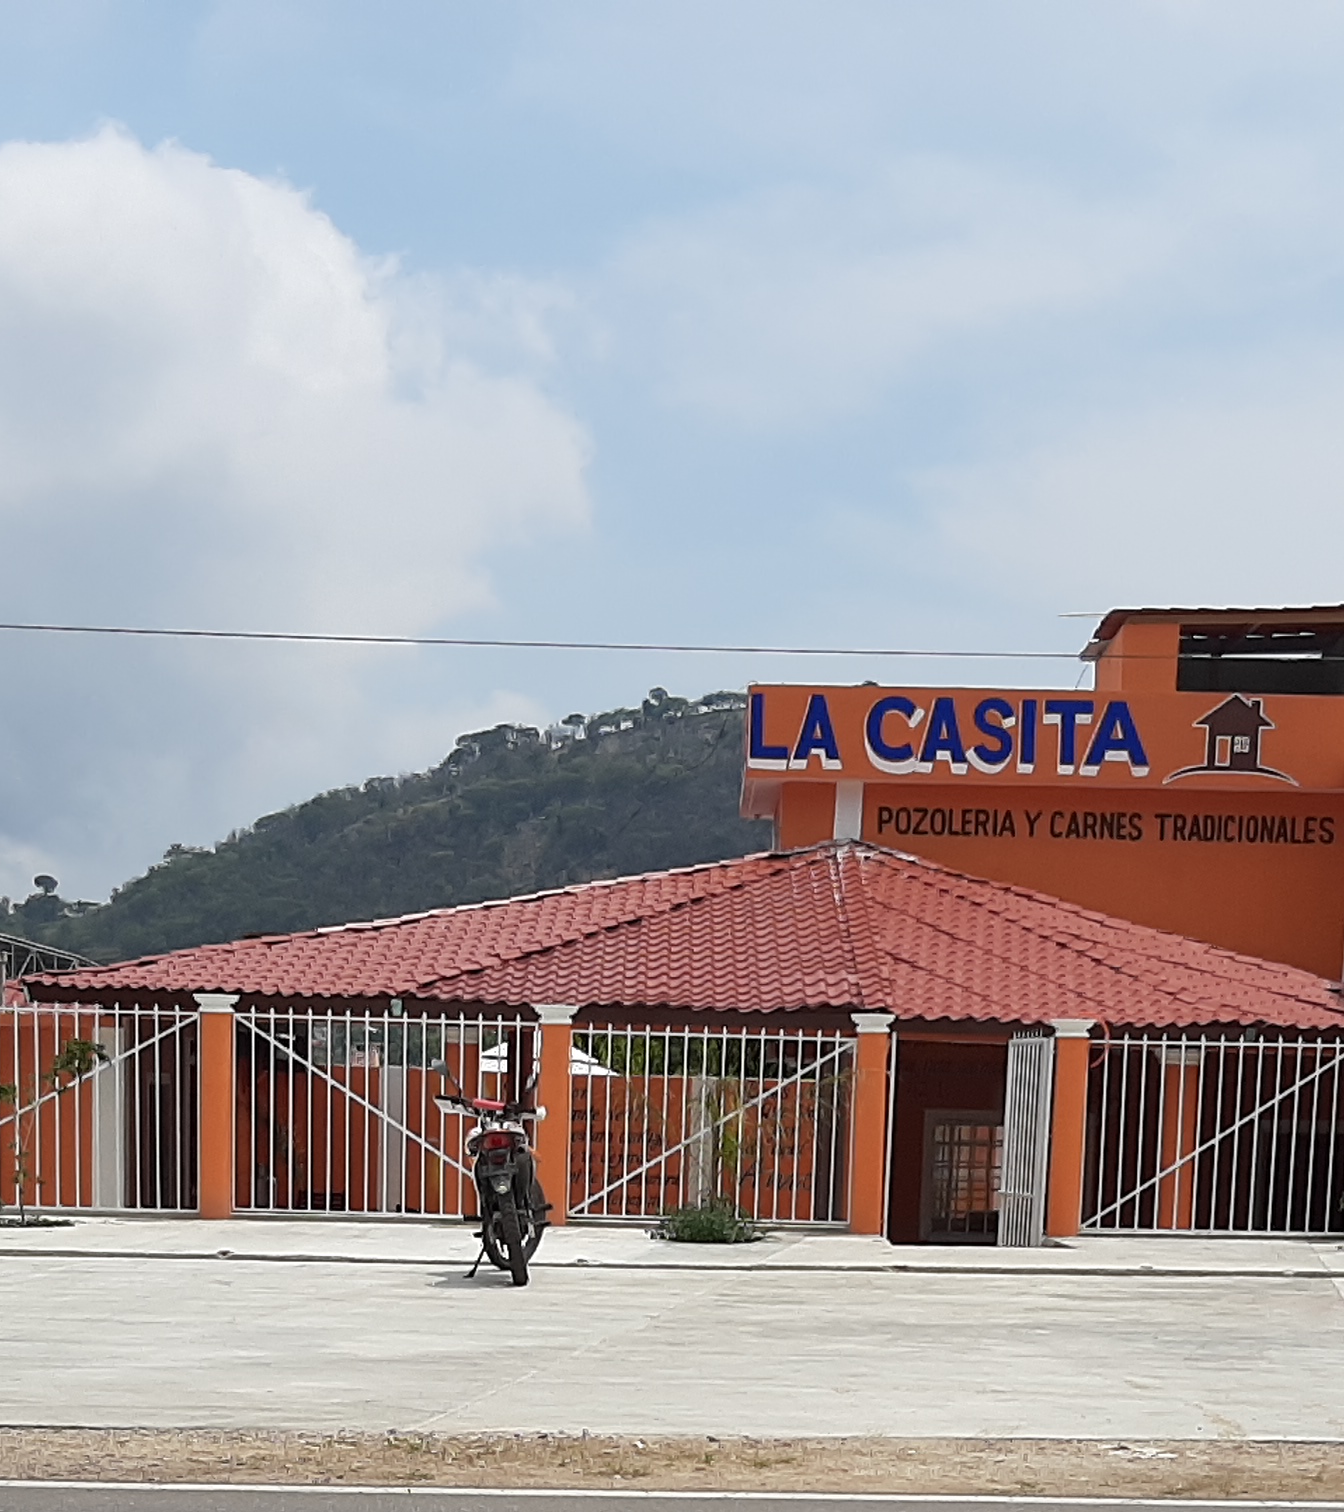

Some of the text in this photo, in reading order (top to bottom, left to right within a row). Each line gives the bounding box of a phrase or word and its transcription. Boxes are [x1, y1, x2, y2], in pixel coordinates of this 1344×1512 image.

[747, 694, 1149, 777] LA CASITA
[877, 806, 1336, 844] POZOLERIA Y CARNES TRADICIONALES
